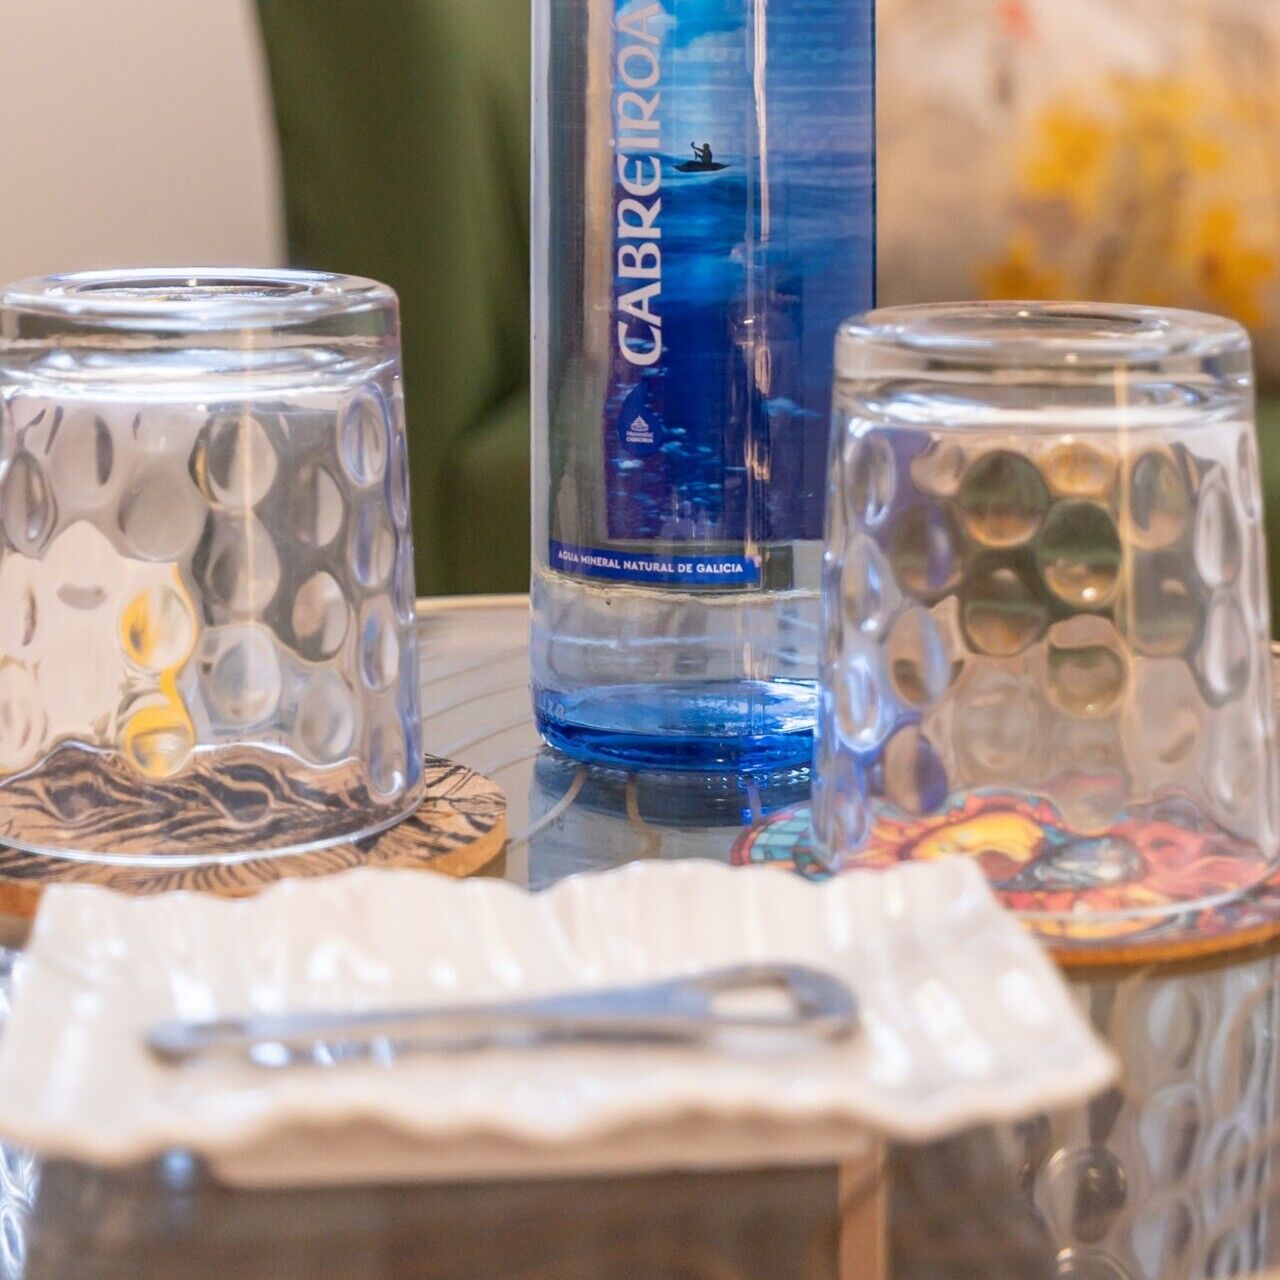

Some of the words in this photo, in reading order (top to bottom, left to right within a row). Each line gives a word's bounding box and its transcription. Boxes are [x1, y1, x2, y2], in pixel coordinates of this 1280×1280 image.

[558, 550, 579, 563] AGUA
[580, 554, 621, 569] MINERAL
[623, 560, 675, 573] NATURAL
[677, 563, 693, 573] DE
[696, 563, 744, 573] GALICIA
